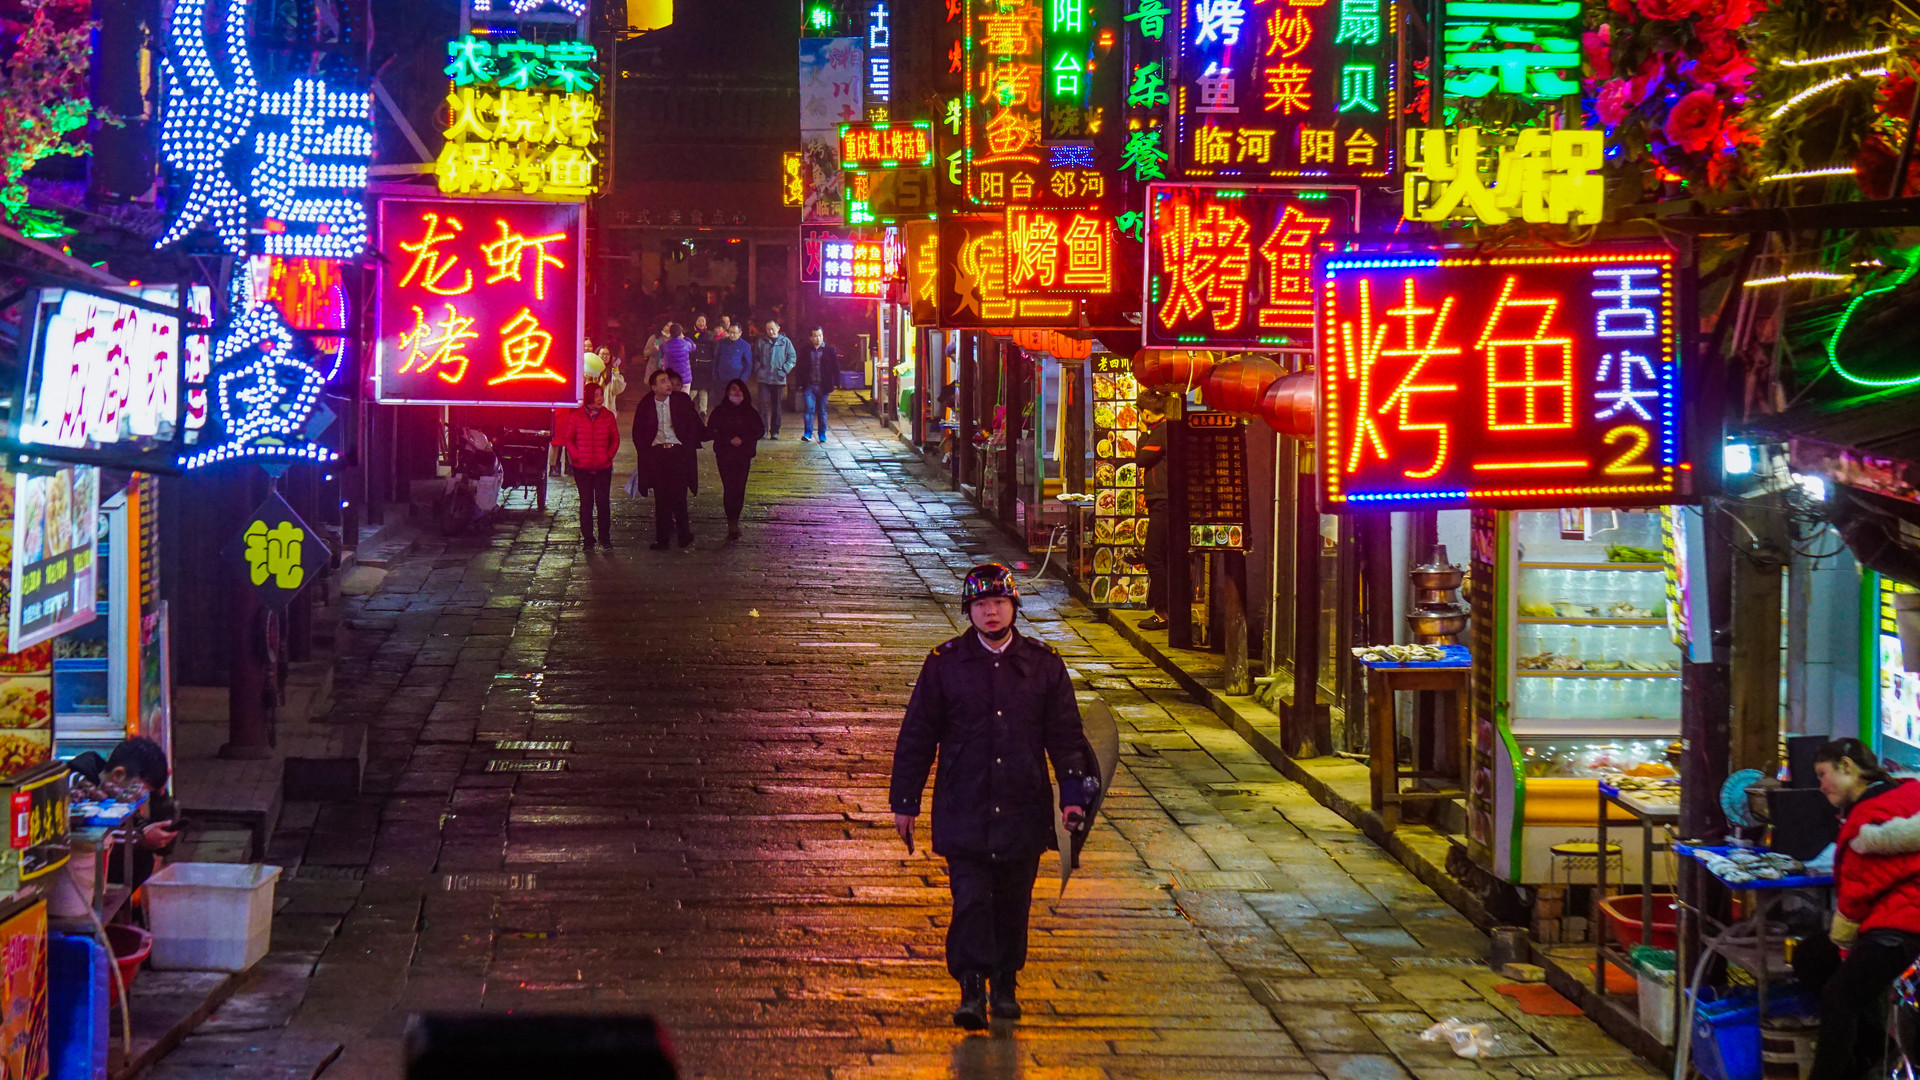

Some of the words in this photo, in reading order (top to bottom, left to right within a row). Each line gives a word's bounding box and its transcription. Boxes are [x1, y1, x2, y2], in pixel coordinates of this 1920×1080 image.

[443, 35, 601, 93] 农家菜
[972, 0, 1040, 166] 葛烤鱼
[1264, 8, 1312, 116] 炒菜
[844, 129, 928, 162] 重庆纸上烤活鱼
[980, 172, 1036, 199] 阳台
[1051, 171, 1105, 199] 邻河
[1300, 127, 1379, 166] 阳台
[1405, 127, 1604, 225] 火锅
[398, 211, 568, 301] 龙虾
[1013, 216, 1107, 287] 烤鱼
[398, 304, 567, 385] 烤鱼
[1341, 274, 1590, 480] 烤鱼
